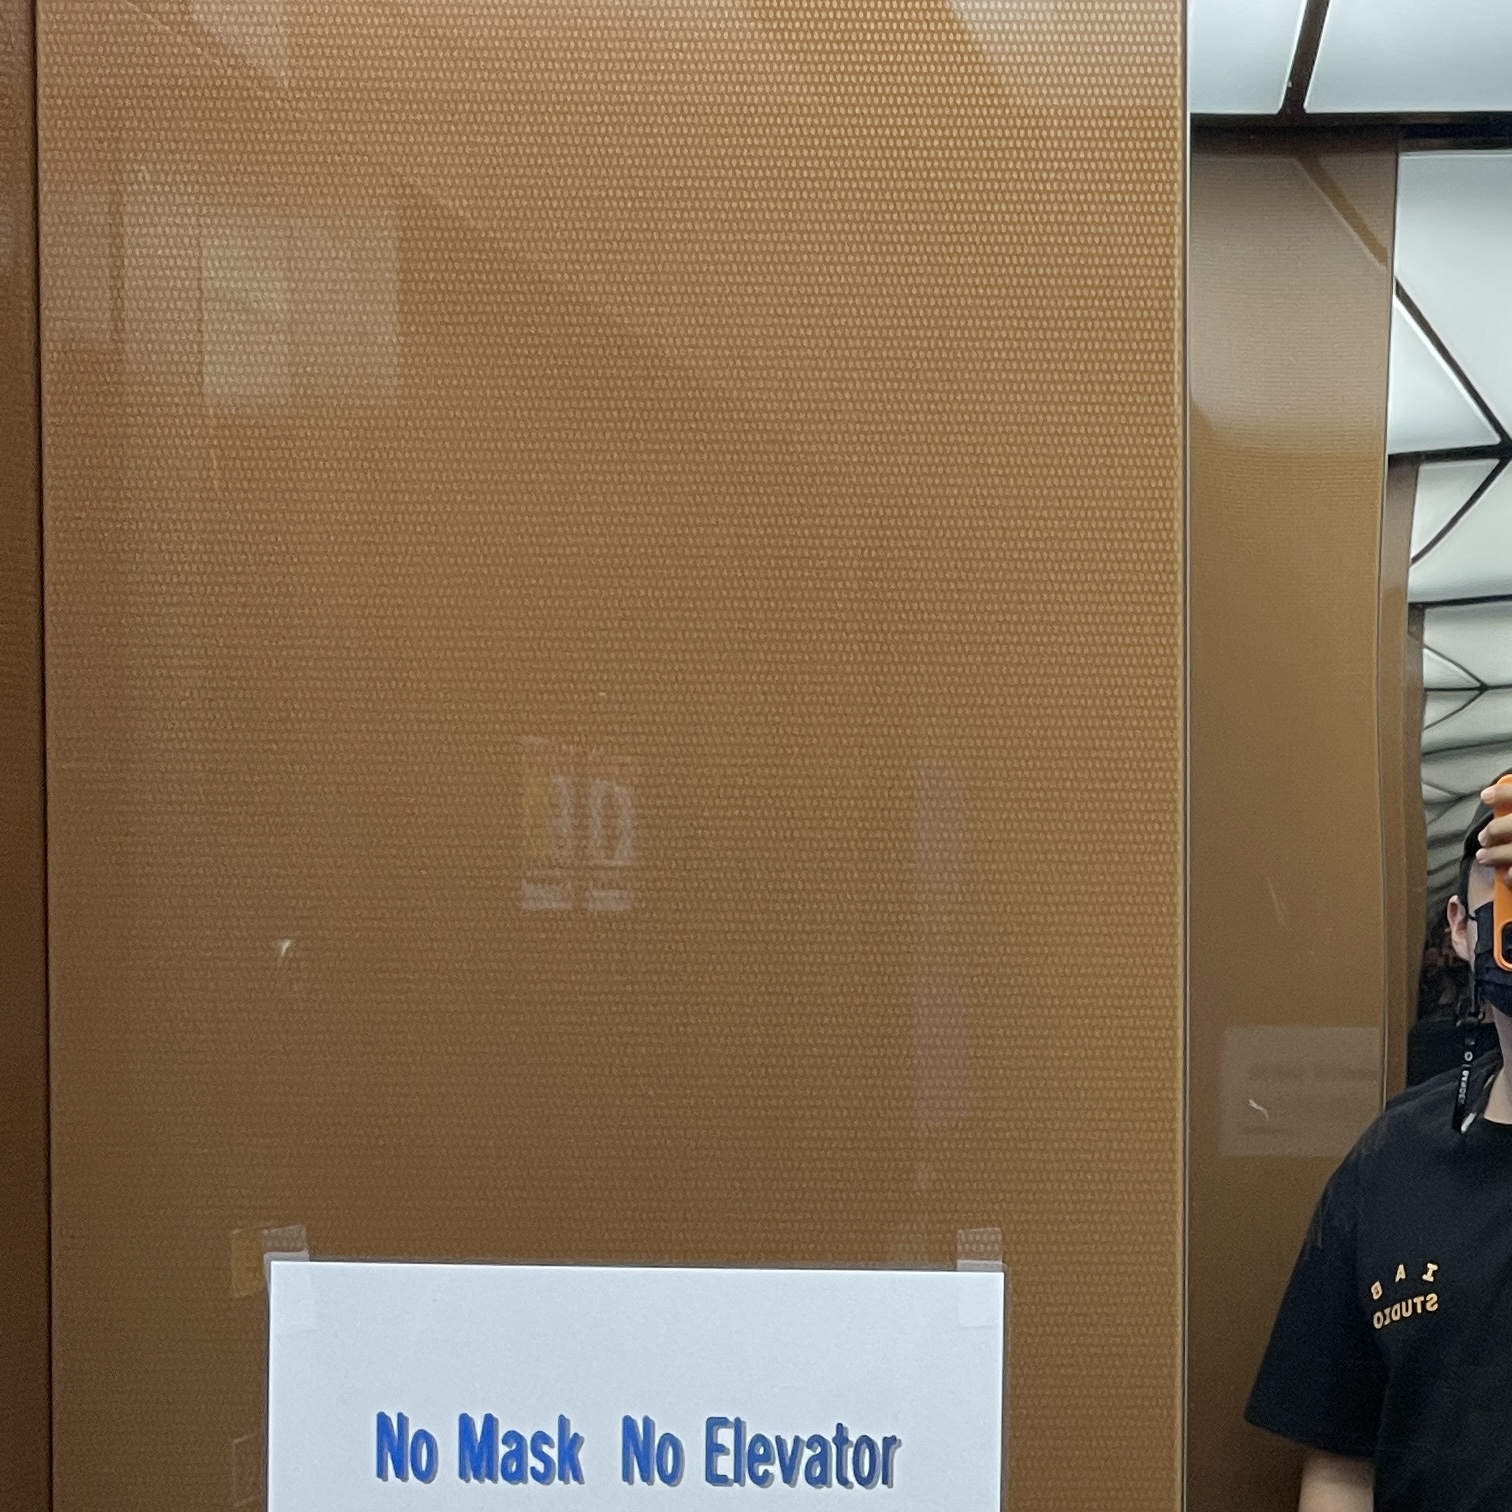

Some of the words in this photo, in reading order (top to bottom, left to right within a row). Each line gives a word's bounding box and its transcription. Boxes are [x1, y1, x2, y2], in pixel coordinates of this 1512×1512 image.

[375, 1410, 438, 1483] No
[457, 1411, 586, 1485] Mask
[621, 1414, 685, 1486] No
[703, 1416, 902, 1489] Elevator
